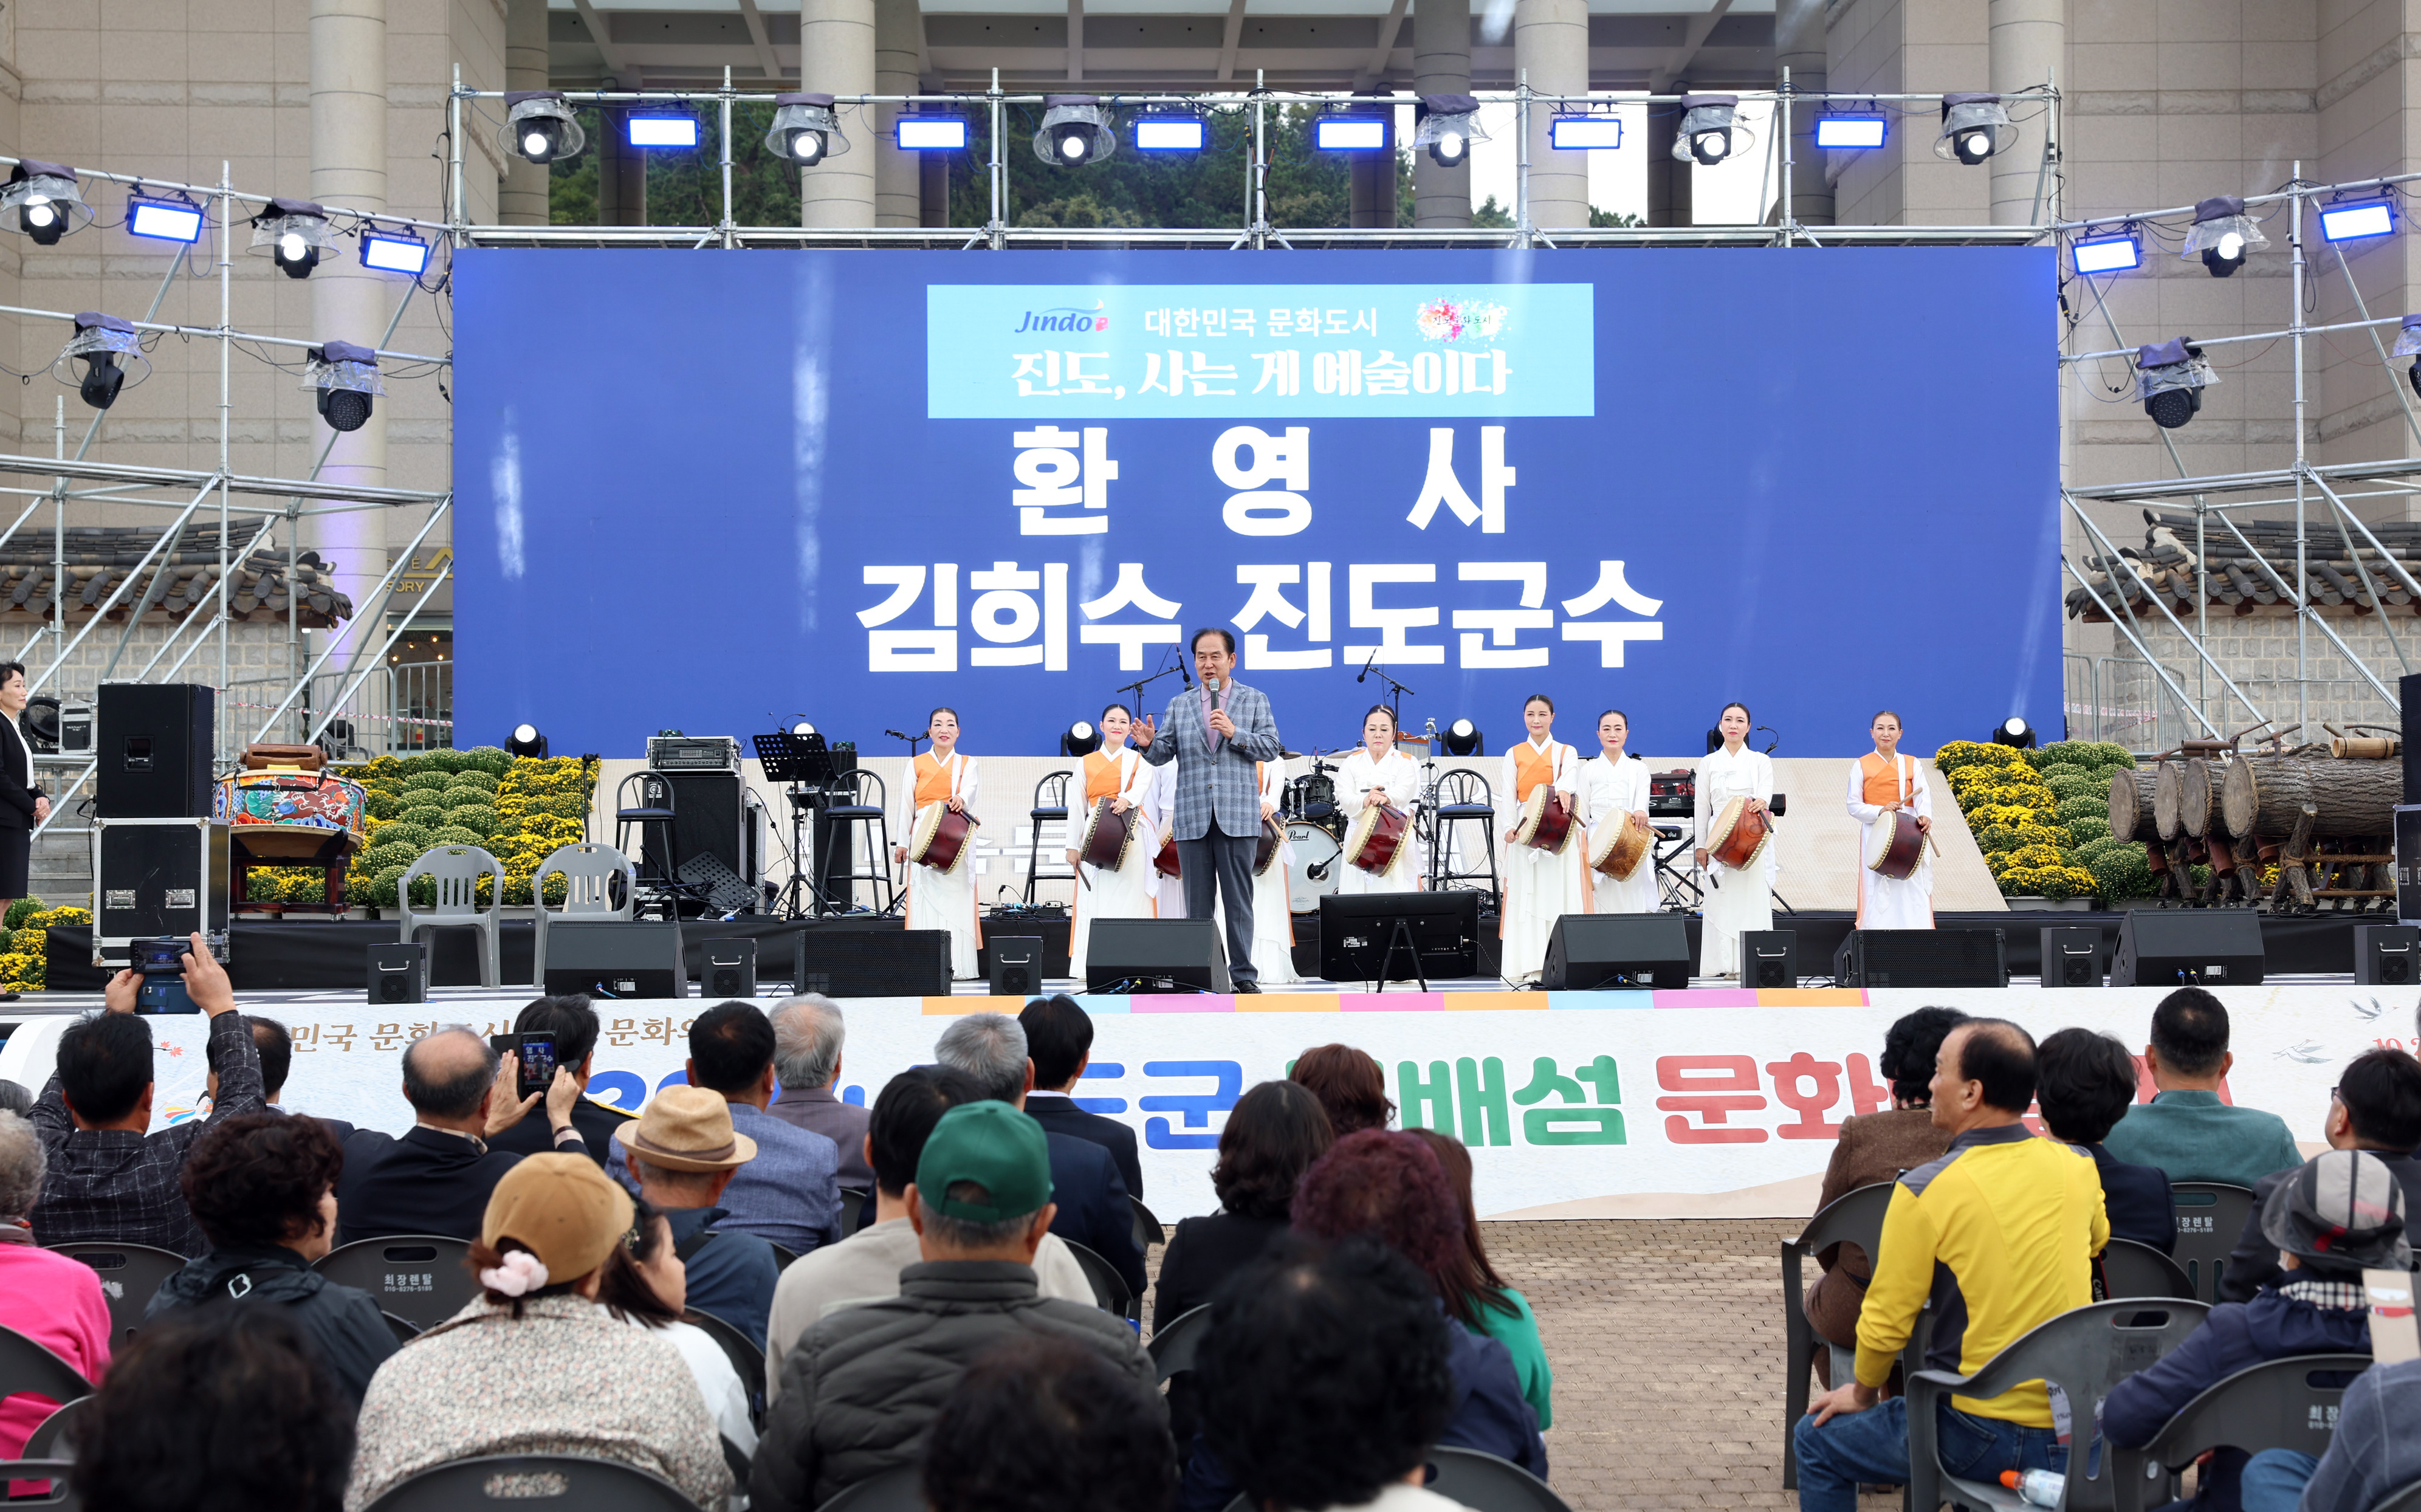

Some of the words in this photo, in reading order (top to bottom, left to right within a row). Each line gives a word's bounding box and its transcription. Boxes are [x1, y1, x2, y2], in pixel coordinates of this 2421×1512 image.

[1014, 311, 1093, 334] Jindo
[1144, 308, 1257, 337] 대한민국
[1266, 307, 1377, 338] 문화도시
[1011, 349, 1126, 400] 진도,
[1137, 348, 1238, 397] 사는
[1250, 348, 1300, 397] 게
[1313, 348, 1512, 397] 예술이다
[1012, 425, 1118, 536] 환
[1212, 425, 1313, 536] 영
[1406, 427, 1516, 534] 사
[856, 561, 1183, 672] 김희수
[1230, 560, 1664, 671] 진도군수
[1288, 830, 1310, 840] Pearl
[369, 1020, 510, 1051] 문화시
[1286, 1054, 1627, 1146] 배섬
